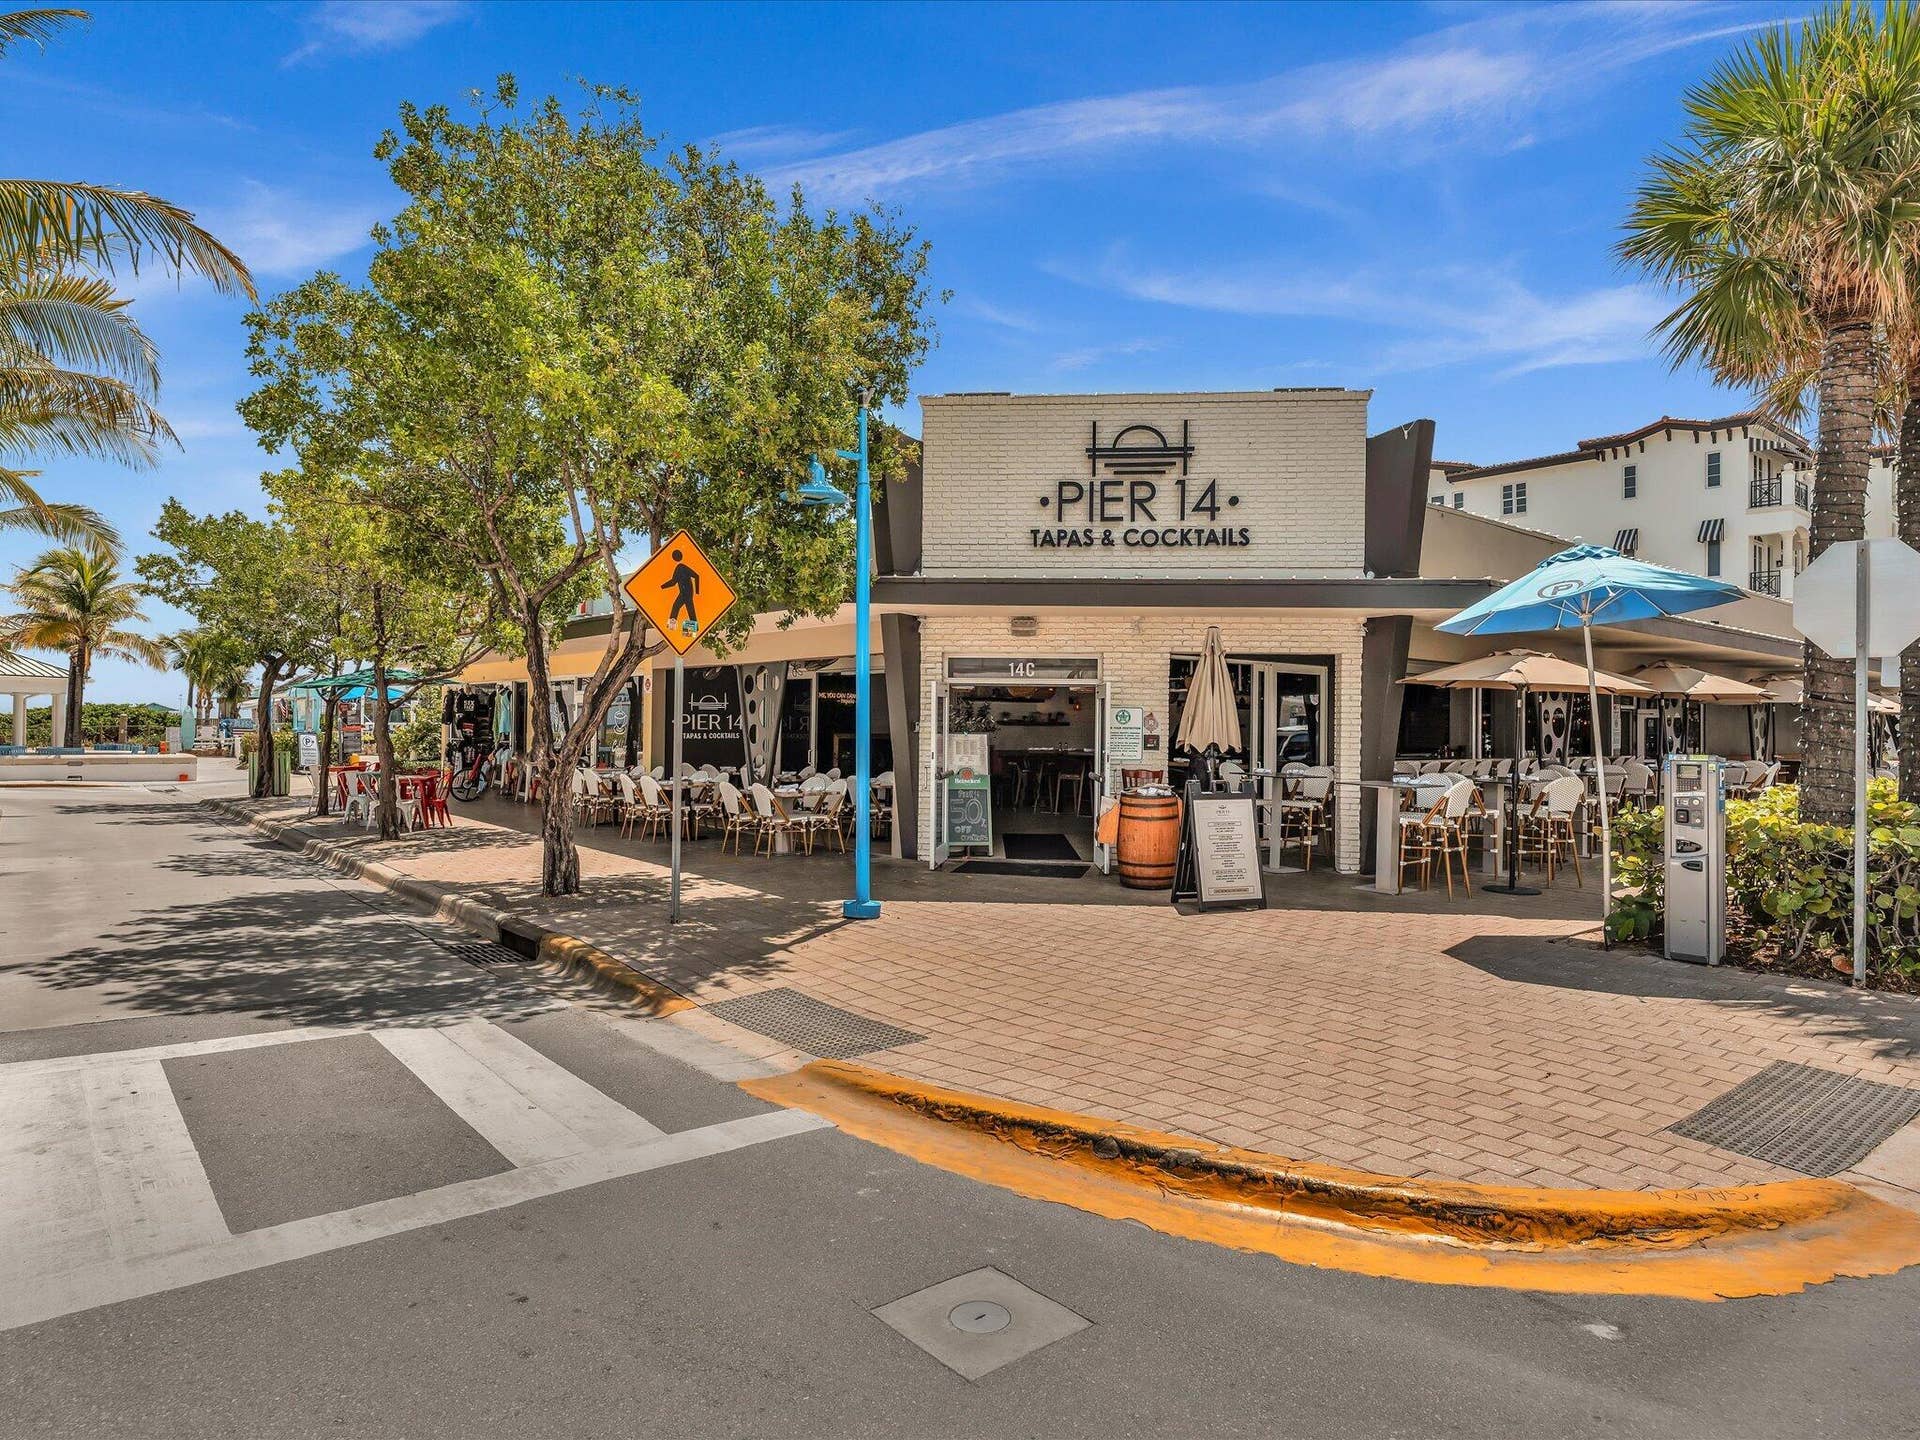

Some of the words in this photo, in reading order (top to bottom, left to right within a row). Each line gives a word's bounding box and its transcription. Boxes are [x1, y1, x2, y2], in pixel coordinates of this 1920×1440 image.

[1057, 480, 1157, 522] PIER
[1174, 478, 1221, 522] 14
[1030, 529, 1094, 547] TAPAS
[1101, 529, 1115, 547] &
[1123, 528, 1250, 547] COCKTAILS
[1008, 662, 1035, 677] 14C
[681, 713, 721, 730] PIER
[726, 713, 742, 730] 14
